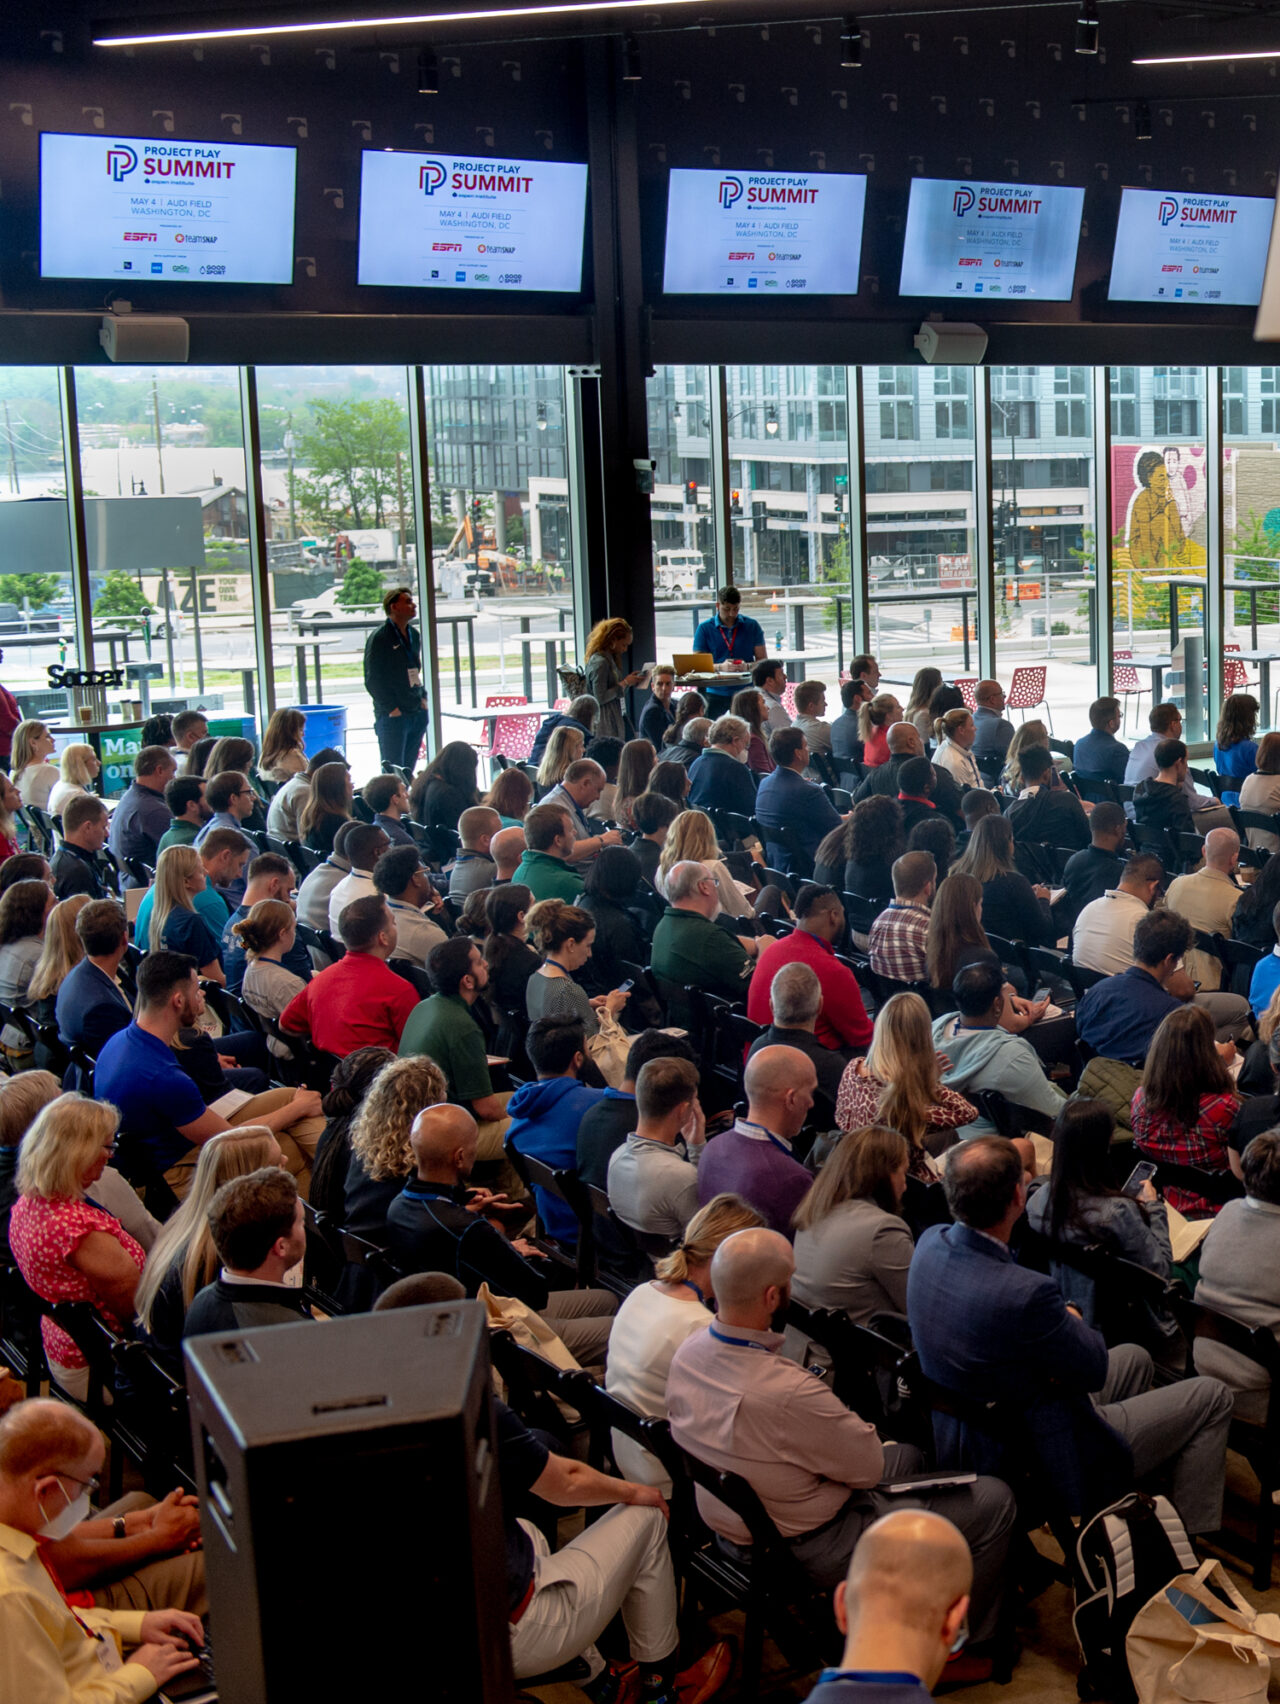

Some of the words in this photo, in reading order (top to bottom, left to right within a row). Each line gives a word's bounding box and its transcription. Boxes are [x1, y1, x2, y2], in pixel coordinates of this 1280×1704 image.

[144, 146, 192, 158] PROJECT
[195, 148, 220, 158] PLAY
[144, 158, 236, 179] SUMMIT
[453, 162, 495, 172] PROJECT
[497, 164, 520, 174] PLAY
[452, 173, 533, 193] SUMMIT
[748, 177, 785, 186] PROJECT
[747, 187, 819, 204] SUMMIT
[980, 188, 1013, 196] PROJECT
[978, 197, 1042, 214] SUMMIT
[1180, 208, 1237, 223] SUMMIT
[124, 232, 157, 242] ESPN
[432, 243, 462, 252] ESPN
[1161, 264, 1182, 272] ESPN
[47, 664, 124, 689] Soccer
